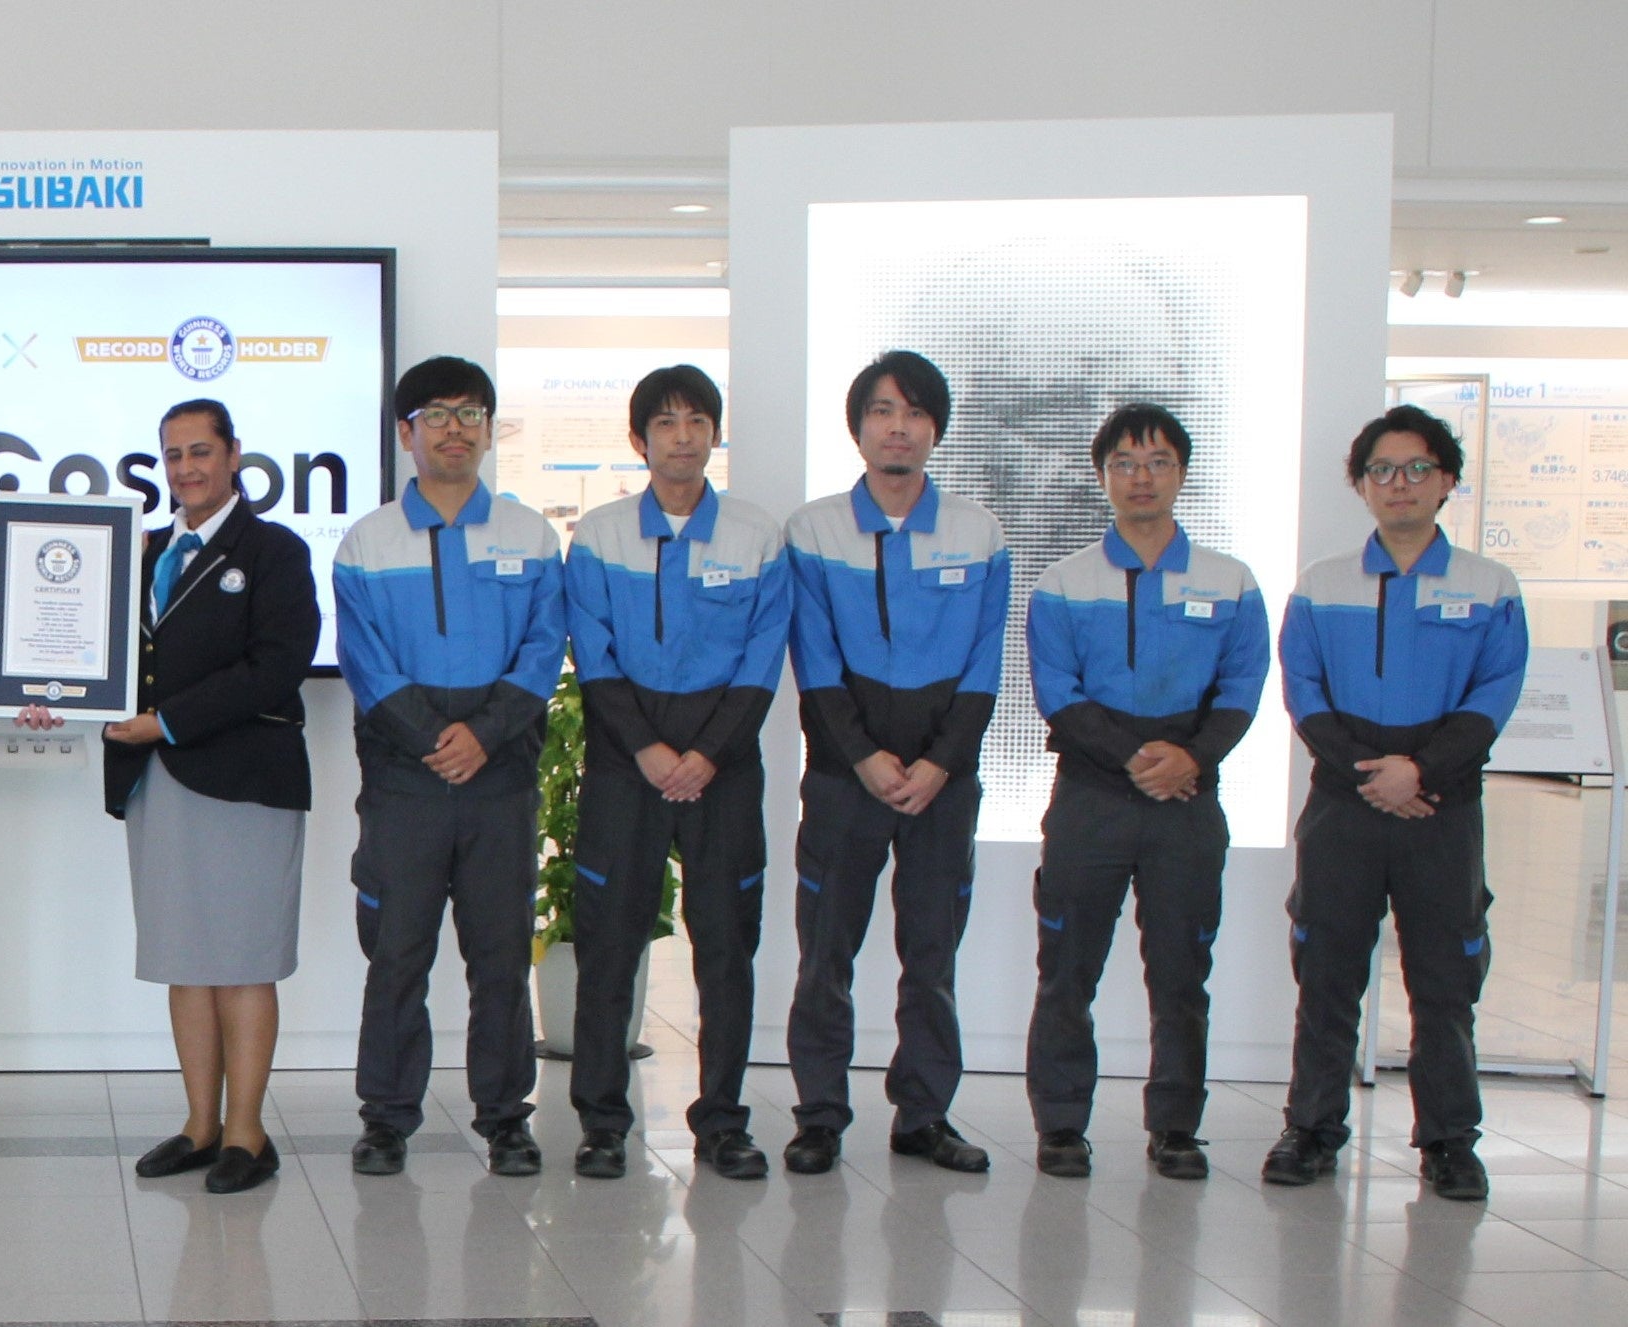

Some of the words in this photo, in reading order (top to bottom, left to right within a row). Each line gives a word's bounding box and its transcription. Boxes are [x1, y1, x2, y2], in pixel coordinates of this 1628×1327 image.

[72, 159, 84, 170] in
[90, 158, 143, 170] Motion
[178, 319, 227, 339] GUINNESS
[84, 341, 164, 357] RECORD
[240, 342, 319, 357] HOLDER
[173, 344, 196, 378] WORLD
[197, 344, 233, 379] RECORDS
[564, 379, 601, 389] CHAIN
